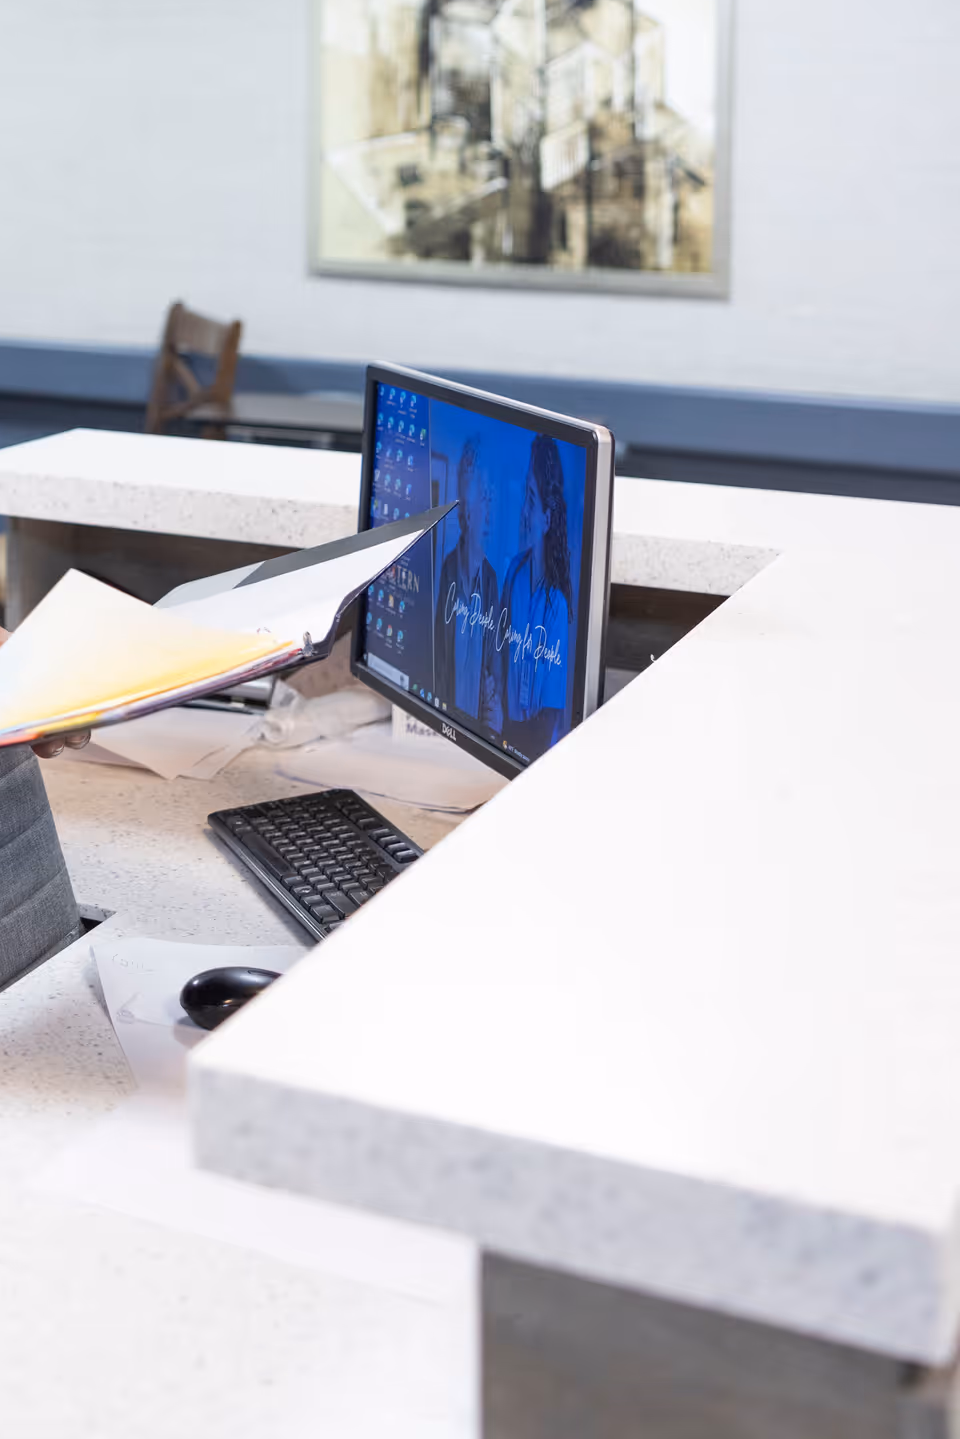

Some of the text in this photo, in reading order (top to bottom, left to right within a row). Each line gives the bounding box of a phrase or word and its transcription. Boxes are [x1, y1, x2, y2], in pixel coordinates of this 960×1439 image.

[444, 581, 470, 635] Caring
[495, 607, 524, 664] Caring
[442, 722, 457, 742] DELL
